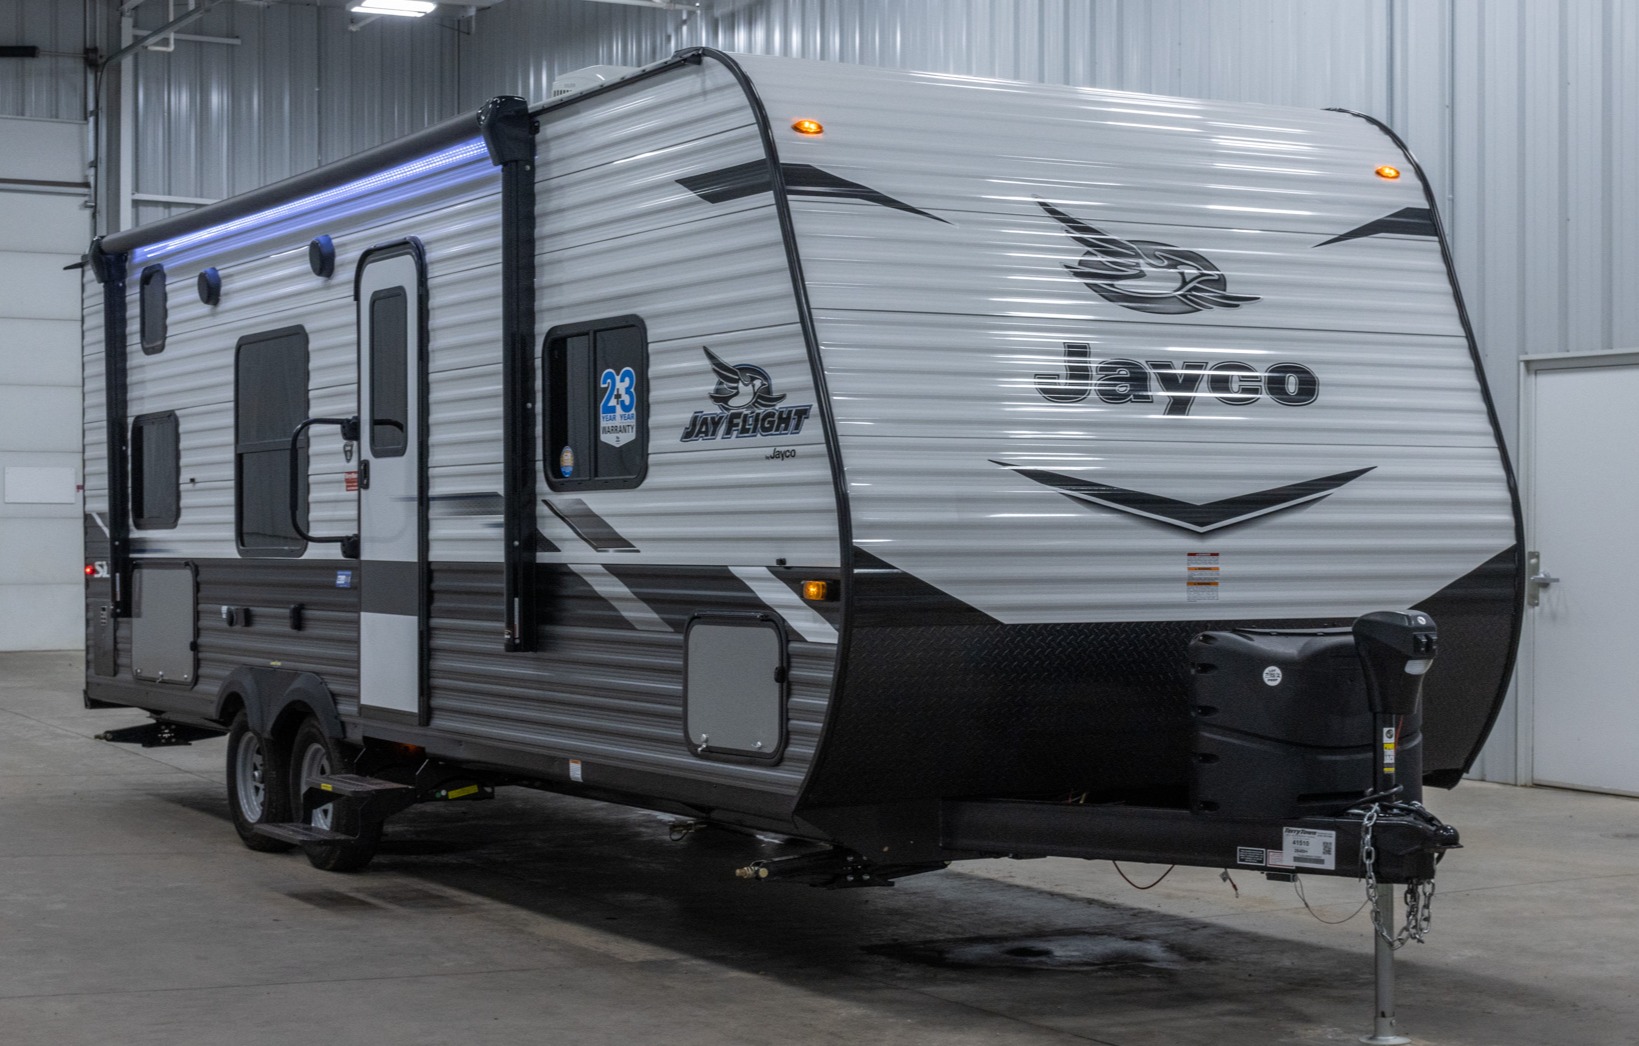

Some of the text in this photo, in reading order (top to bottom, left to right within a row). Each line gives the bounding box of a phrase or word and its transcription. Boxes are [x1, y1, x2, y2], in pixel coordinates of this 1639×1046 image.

[1034, 342, 1319, 416] Jayco
[602, 424, 634, 434] WARRANTY
[680, 404, 813, 442] JAY FLIGHT
[770, 447, 796, 461] Jayco
[94, 561, 111, 577] SL
